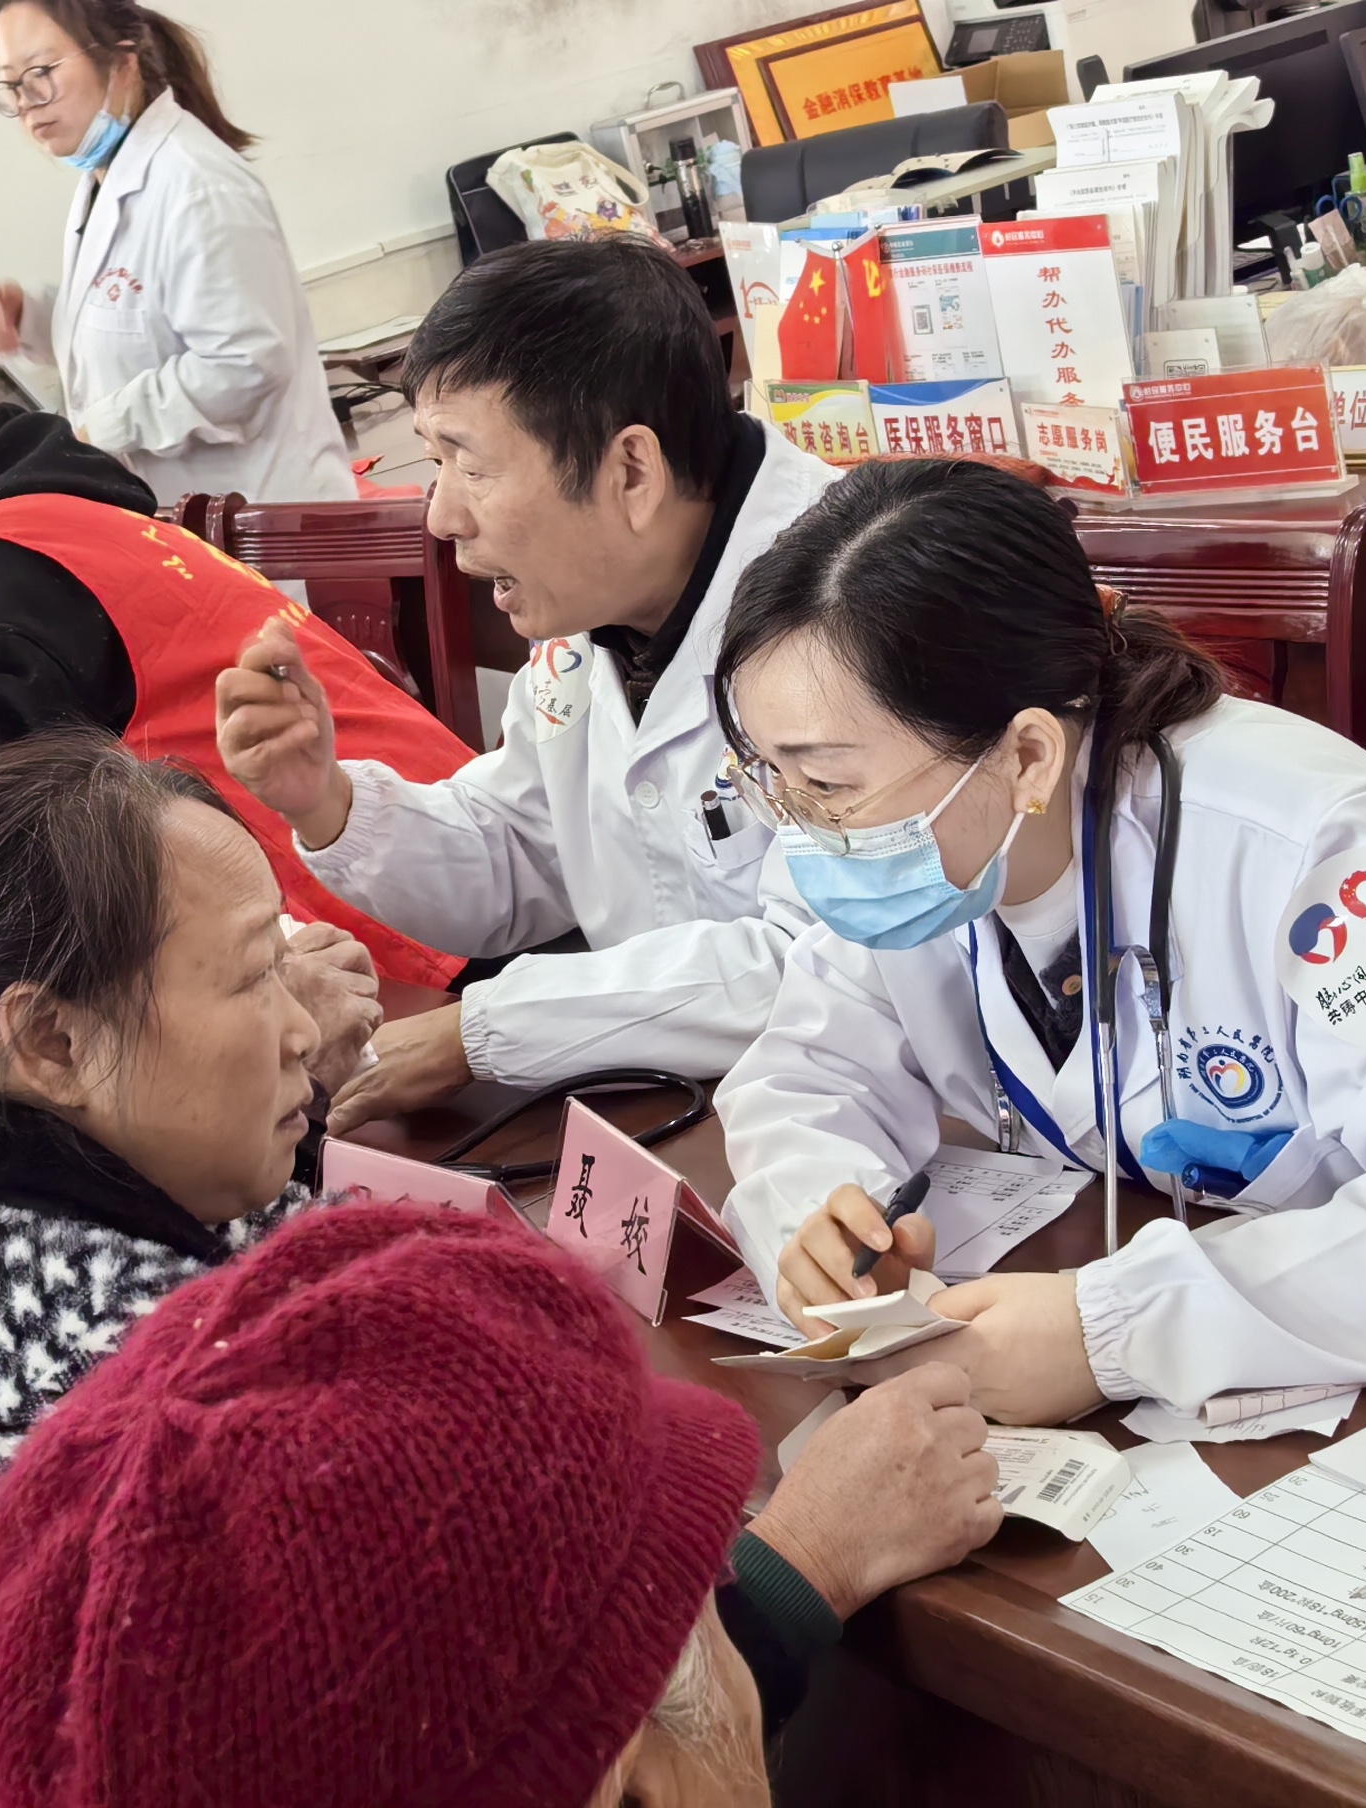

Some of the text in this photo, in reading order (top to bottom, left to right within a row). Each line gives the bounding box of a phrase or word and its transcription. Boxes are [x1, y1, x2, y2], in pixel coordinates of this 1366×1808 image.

[1037, 266, 1085, 406] 帮办代办服务
[783, 420, 870, 455] 政策咨询台
[882, 411, 1008, 454] 医保服务窗口
[1036, 422, 1108, 455] 志愿服务岗
[1147, 405, 1321, 465] 便民服务台
[1231, 1509, 1252, 1520] 60
[1144, 1561, 1164, 1572] 40
[1174, 1544, 1197, 1557] 30
[1114, 1577, 1136, 1589] 30
